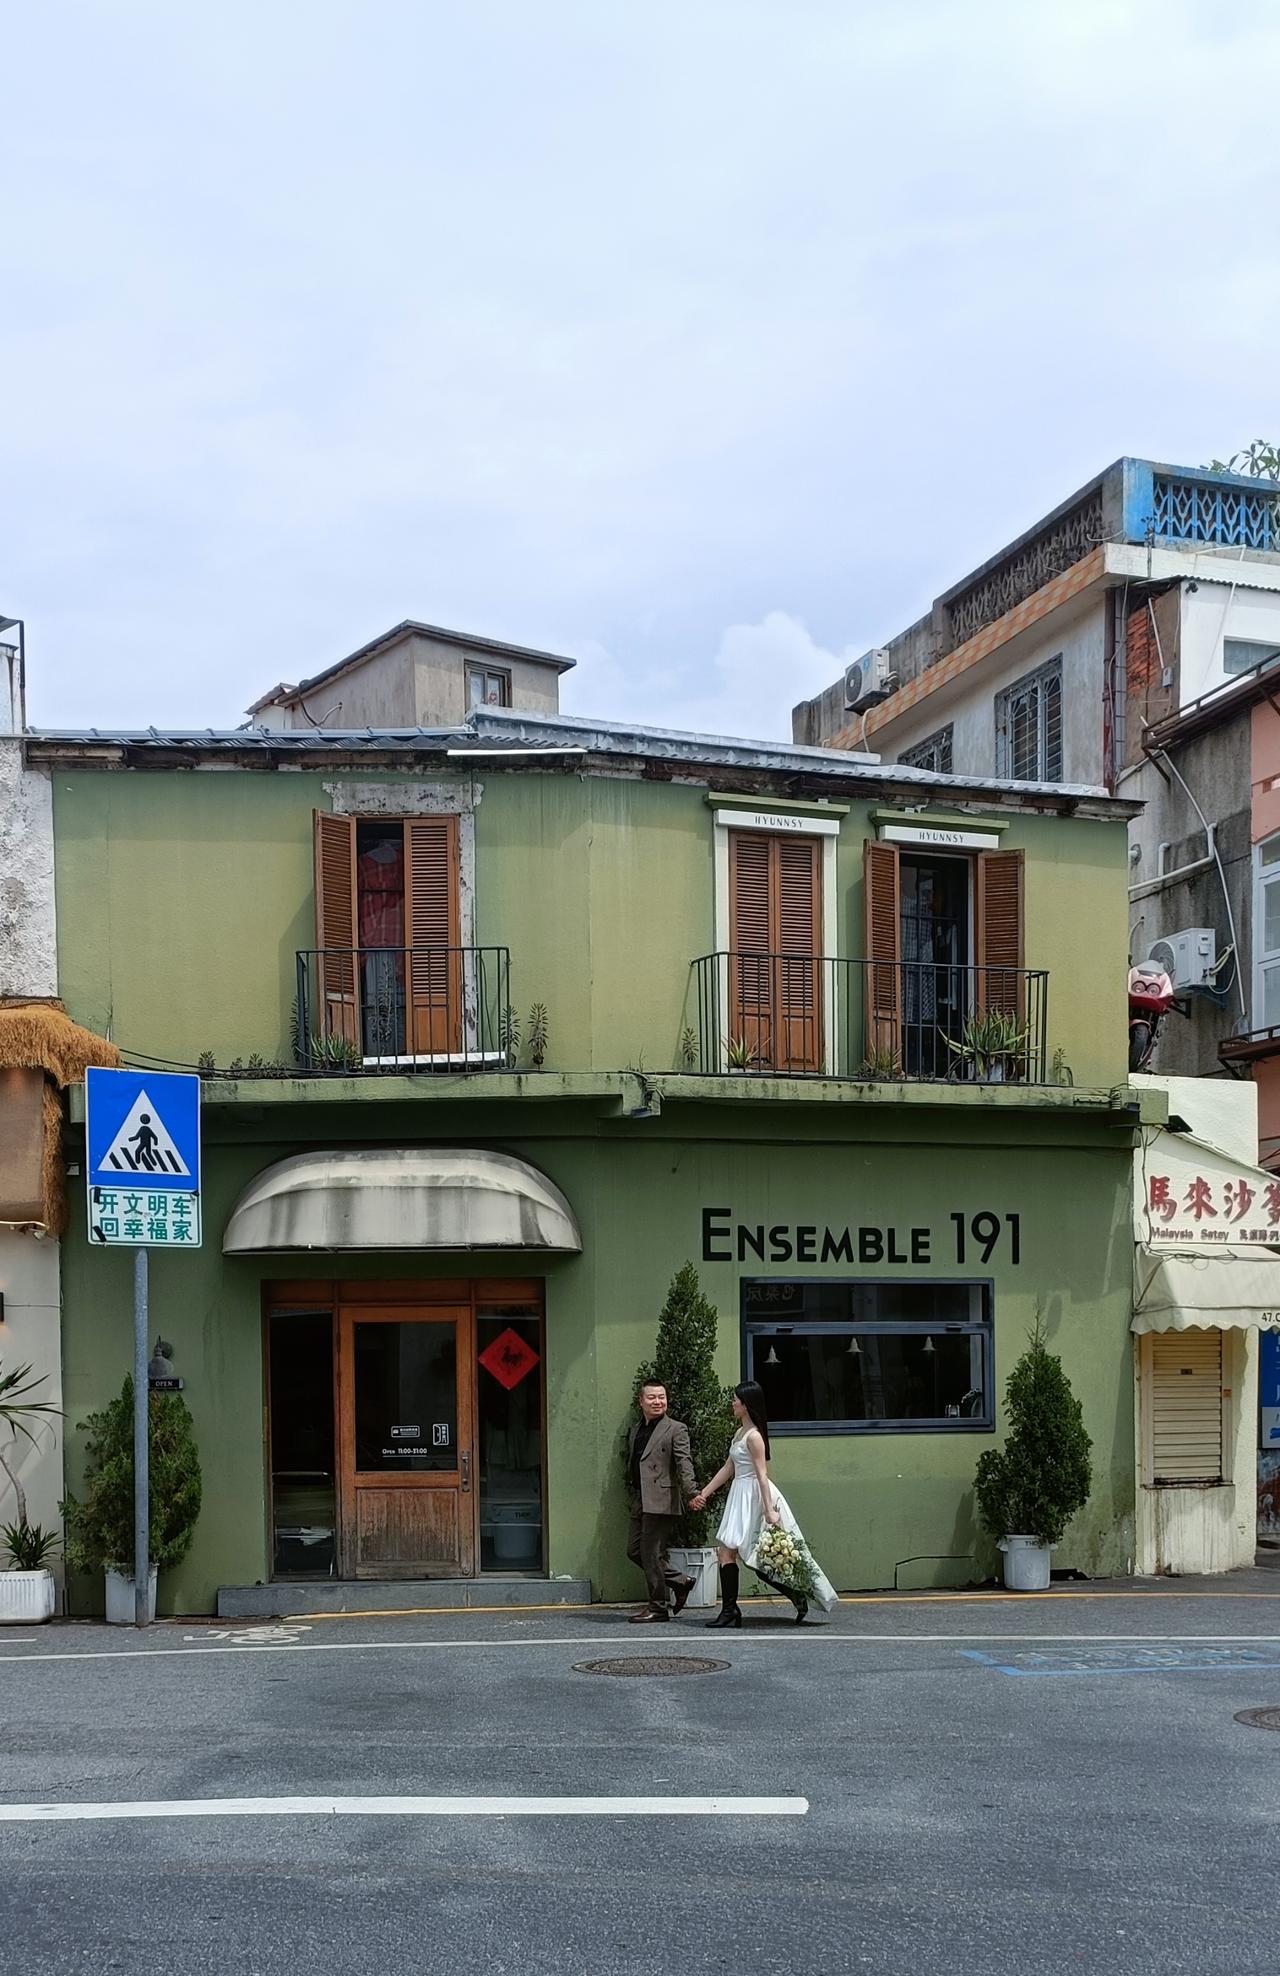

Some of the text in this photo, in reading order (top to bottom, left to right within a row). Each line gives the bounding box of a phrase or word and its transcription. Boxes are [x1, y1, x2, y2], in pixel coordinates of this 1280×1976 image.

[755, 815, 804, 829] HYUNNSY
[919, 831, 965, 844] HYUNNSY
[99, 1193, 192, 1217] 开文明车
[100, 1217, 193, 1241] 回幸福家
[702, 1208, 1020, 1265] ENSEMBLE 191
[1151, 1226, 1194, 1240] Malaysia
